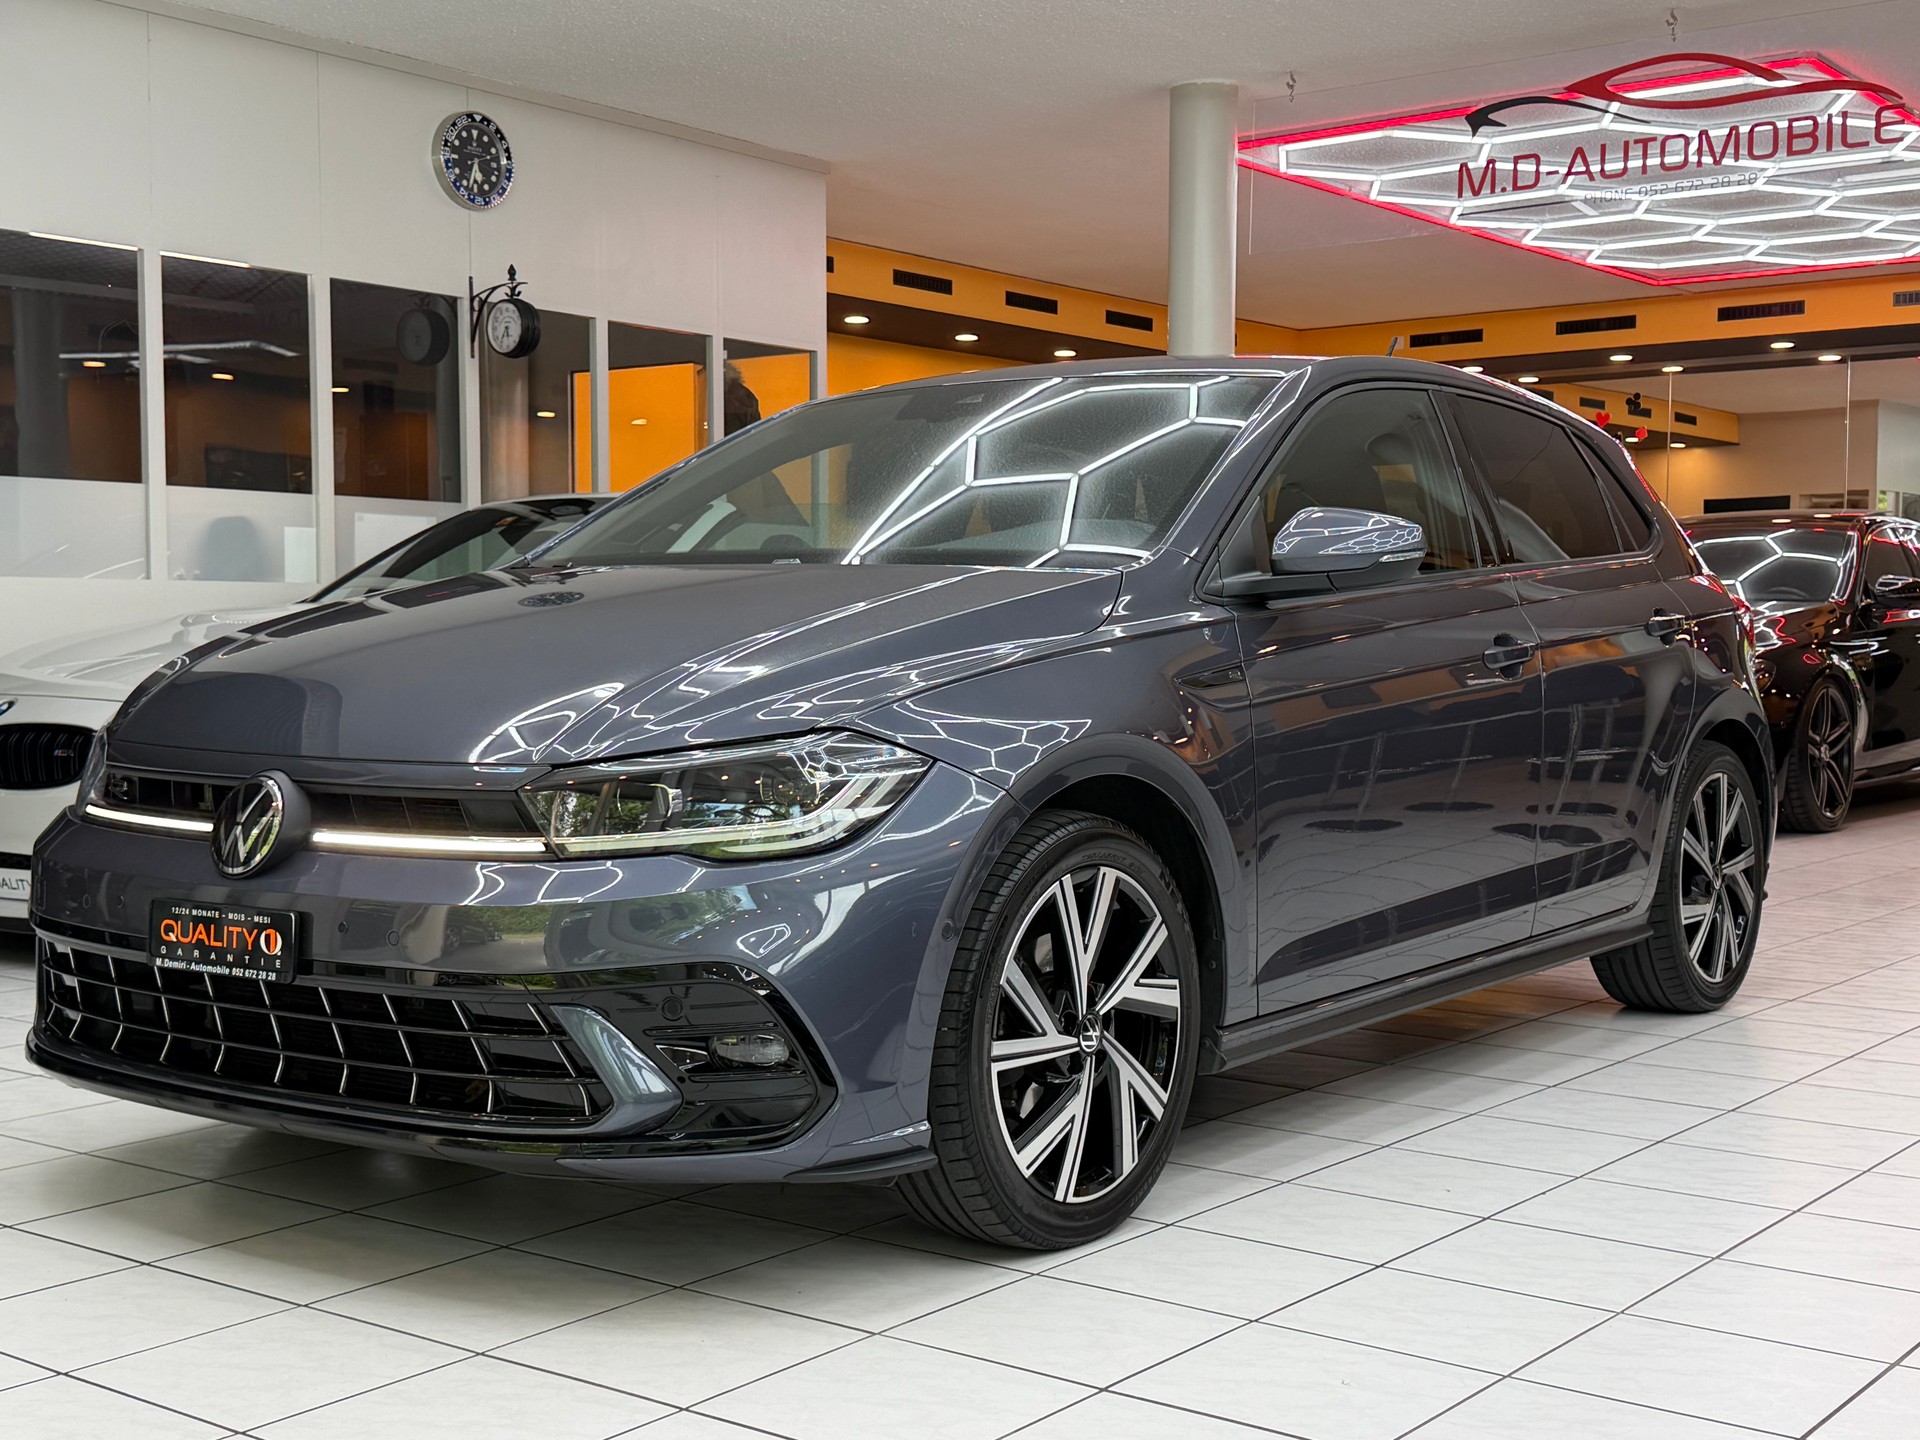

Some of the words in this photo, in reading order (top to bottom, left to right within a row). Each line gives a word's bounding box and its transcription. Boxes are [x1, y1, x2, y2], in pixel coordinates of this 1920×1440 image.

[1457, 102, 1906, 199] M.D-AUTOMOBILE
[1638, 183, 1669, 198] 052
[1674, 179, 1704, 194] 672
[1710, 175, 1731, 189] 28
[1737, 172, 1758, 185] 28
[171, 906, 190, 916] 12/24
[191, 909, 220, 919] MONATE
[228, 912, 246, 922] MOIS
[253, 915, 271, 924] MESI
[160, 918, 259, 951] QUALITY
[231, 967, 244, 977] 052
[257, 970, 267, 980] 28
[267, 971, 277, 981] 28
